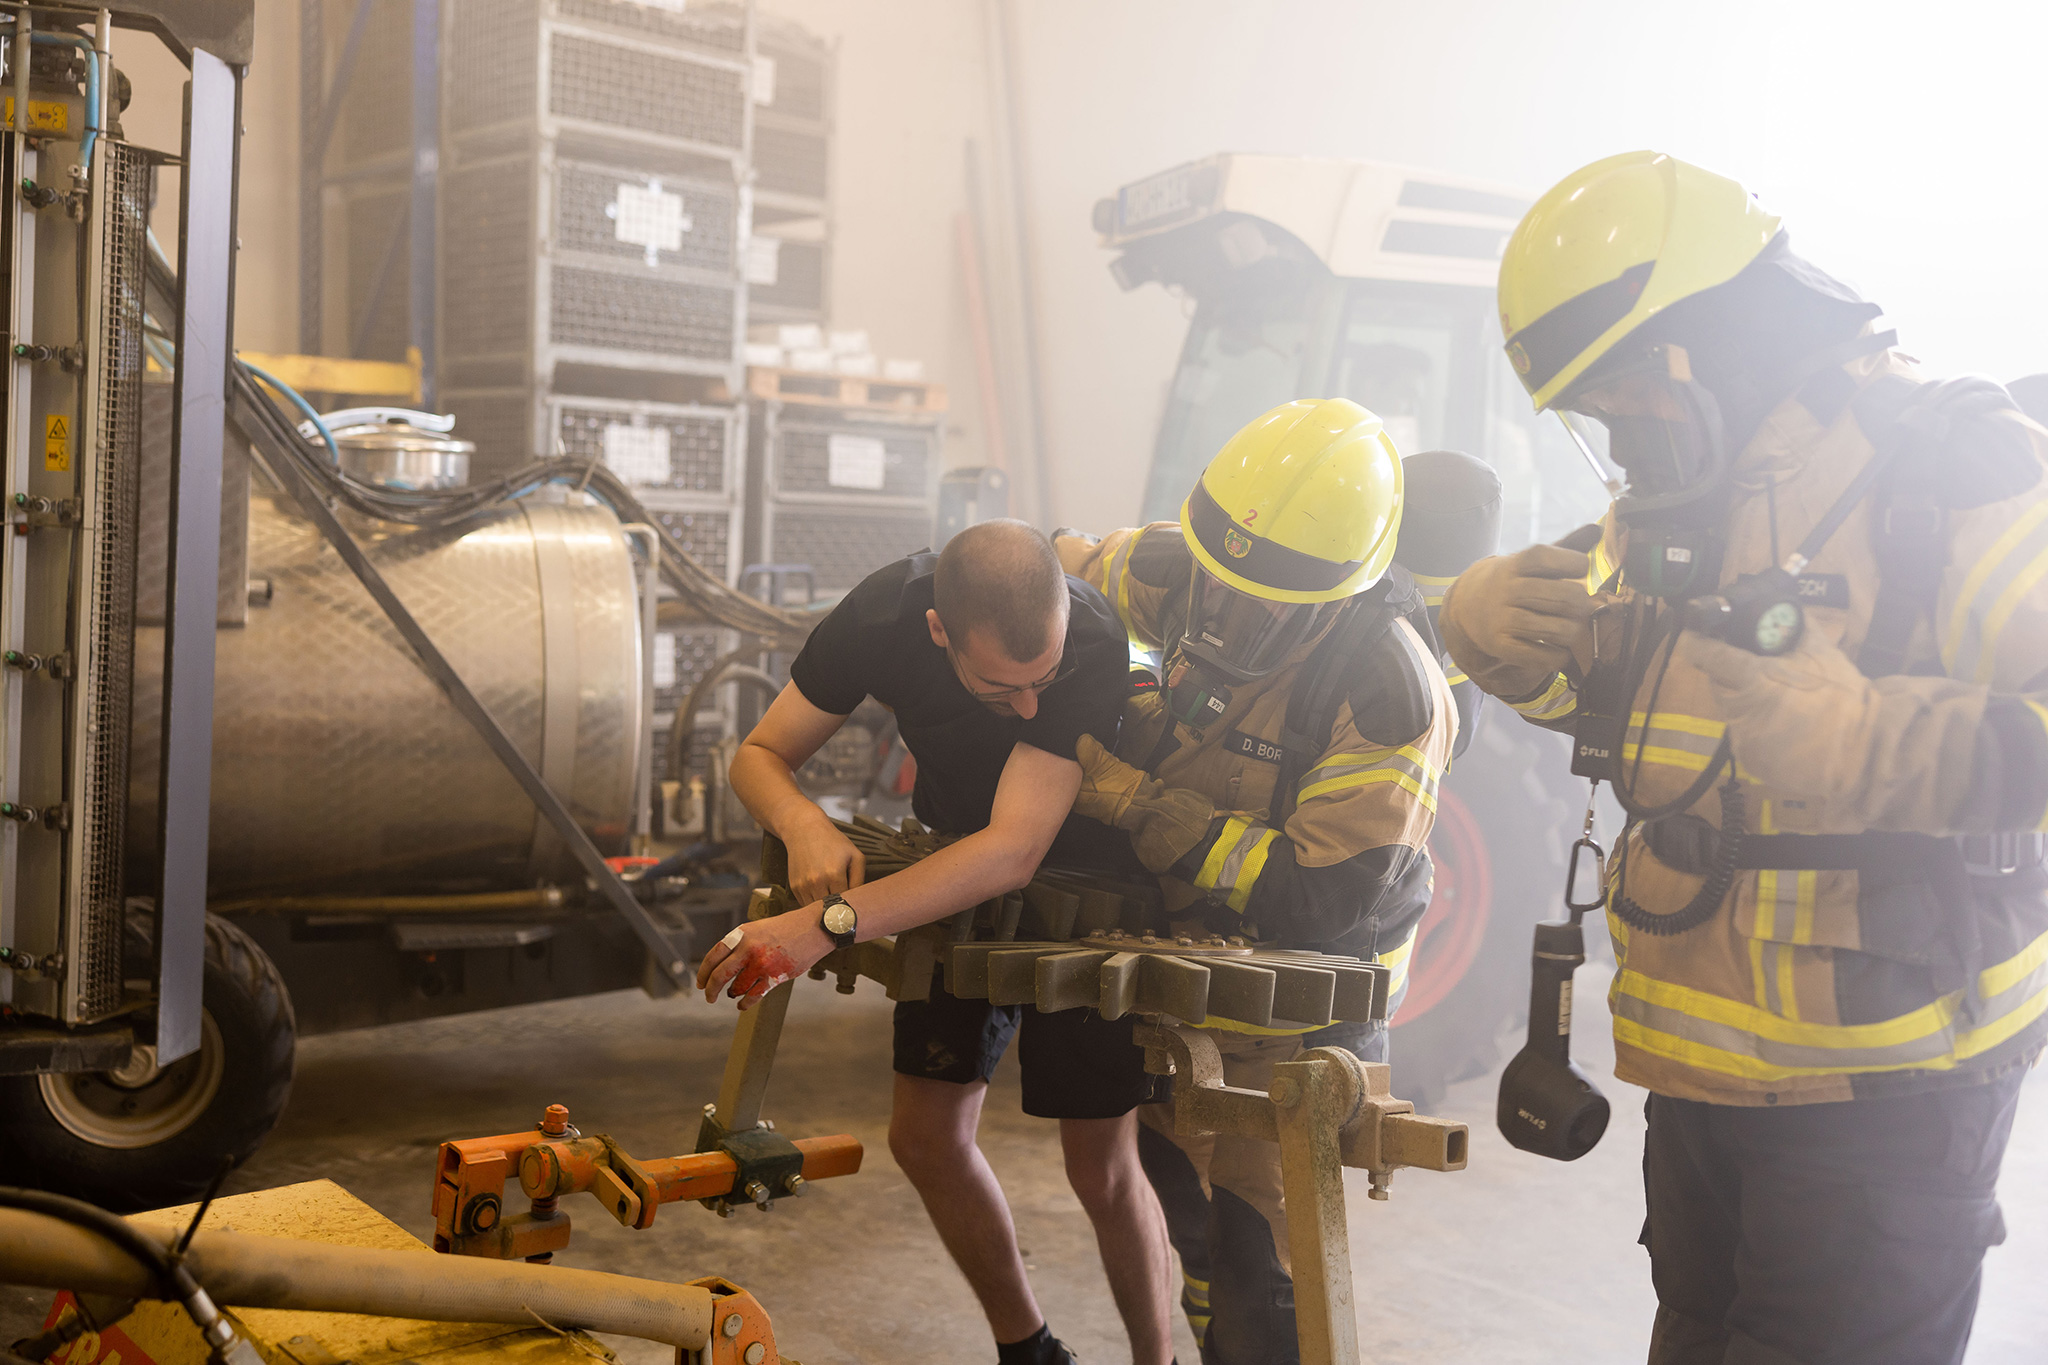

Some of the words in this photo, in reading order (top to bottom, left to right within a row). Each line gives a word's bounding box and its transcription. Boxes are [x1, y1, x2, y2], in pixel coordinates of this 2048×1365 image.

[1502, 313, 1513, 334] 2
[1242, 508, 1258, 528] 2
[1241, 737, 1253, 752] D.
